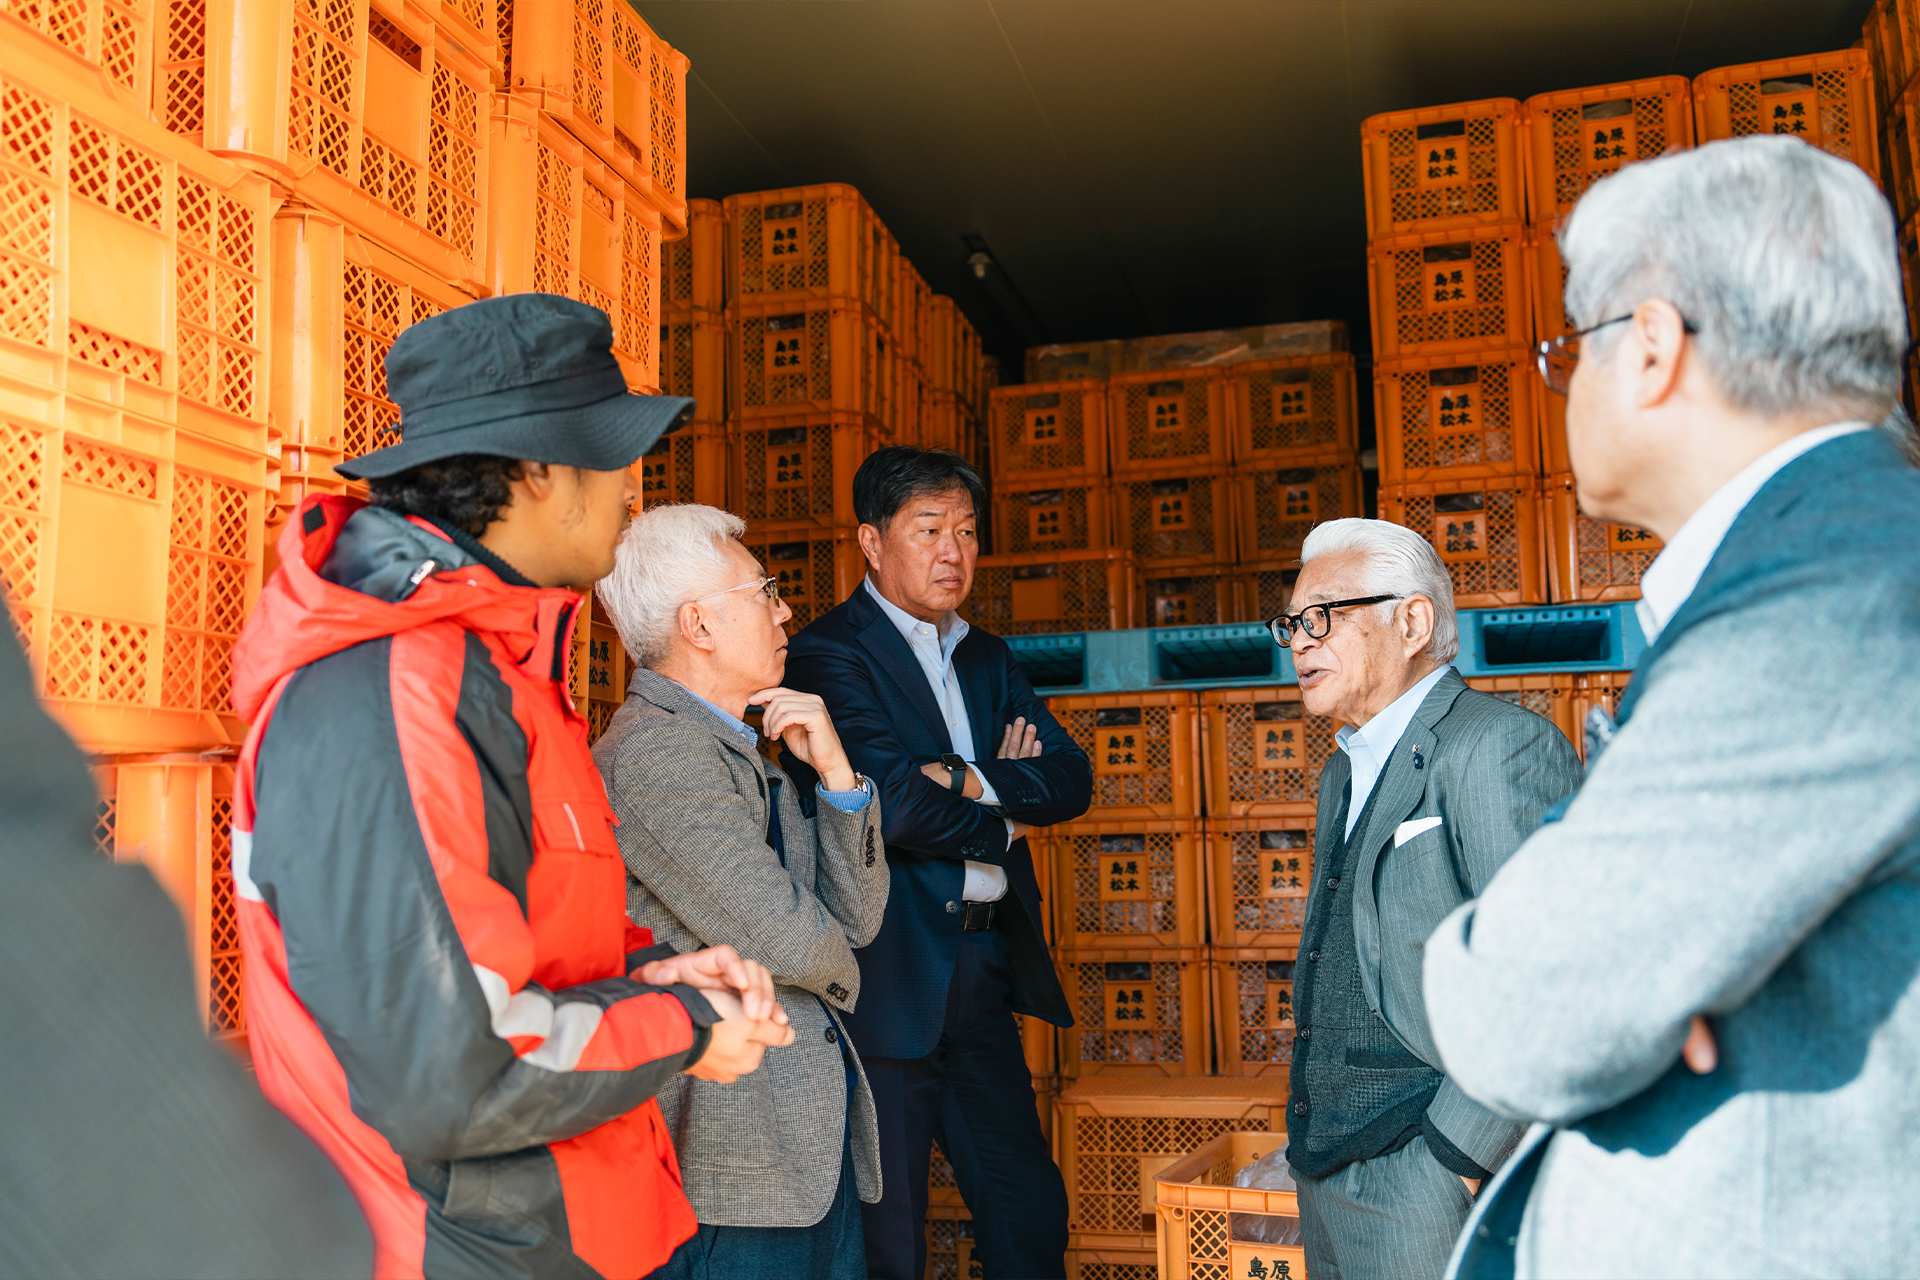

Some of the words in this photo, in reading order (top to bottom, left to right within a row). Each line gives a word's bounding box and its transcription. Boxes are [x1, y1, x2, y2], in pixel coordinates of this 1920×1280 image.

[1773, 103, 1805, 119] 島原
[1773, 118, 1807, 135] 松本
[1594, 128, 1624, 144] 島原
[1429, 148, 1456, 163] 島原
[1594, 145, 1627, 160] 松本
[1428, 165, 1458, 179] 松本
[1435, 270, 1463, 286] 島原
[1434, 288, 1465, 302] 松本
[1440, 394, 1470, 411] 島原
[1440, 412, 1472, 427] 松本
[1446, 521, 1475, 537] 島原
[1617, 527, 1651, 542] 松本
[1446, 537, 1478, 553] 松本
[590, 638, 609, 662] 島原
[589, 664, 609, 688] 松本
[1108, 735, 1135, 749] 島原
[1266, 730, 1294, 744] 島原
[1108, 752, 1136, 765] 松本
[1265, 747, 1296, 760] 松本
[1111, 861, 1138, 875] 島原
[1272, 858, 1300, 873] 島原
[1110, 878, 1139, 891] 松本
[1271, 876, 1302, 889] 松本
[1116, 990, 1144, 1004] 島原
[1115, 1007, 1145, 1020] 松本
[1248, 1257, 1292, 1280] 島原
